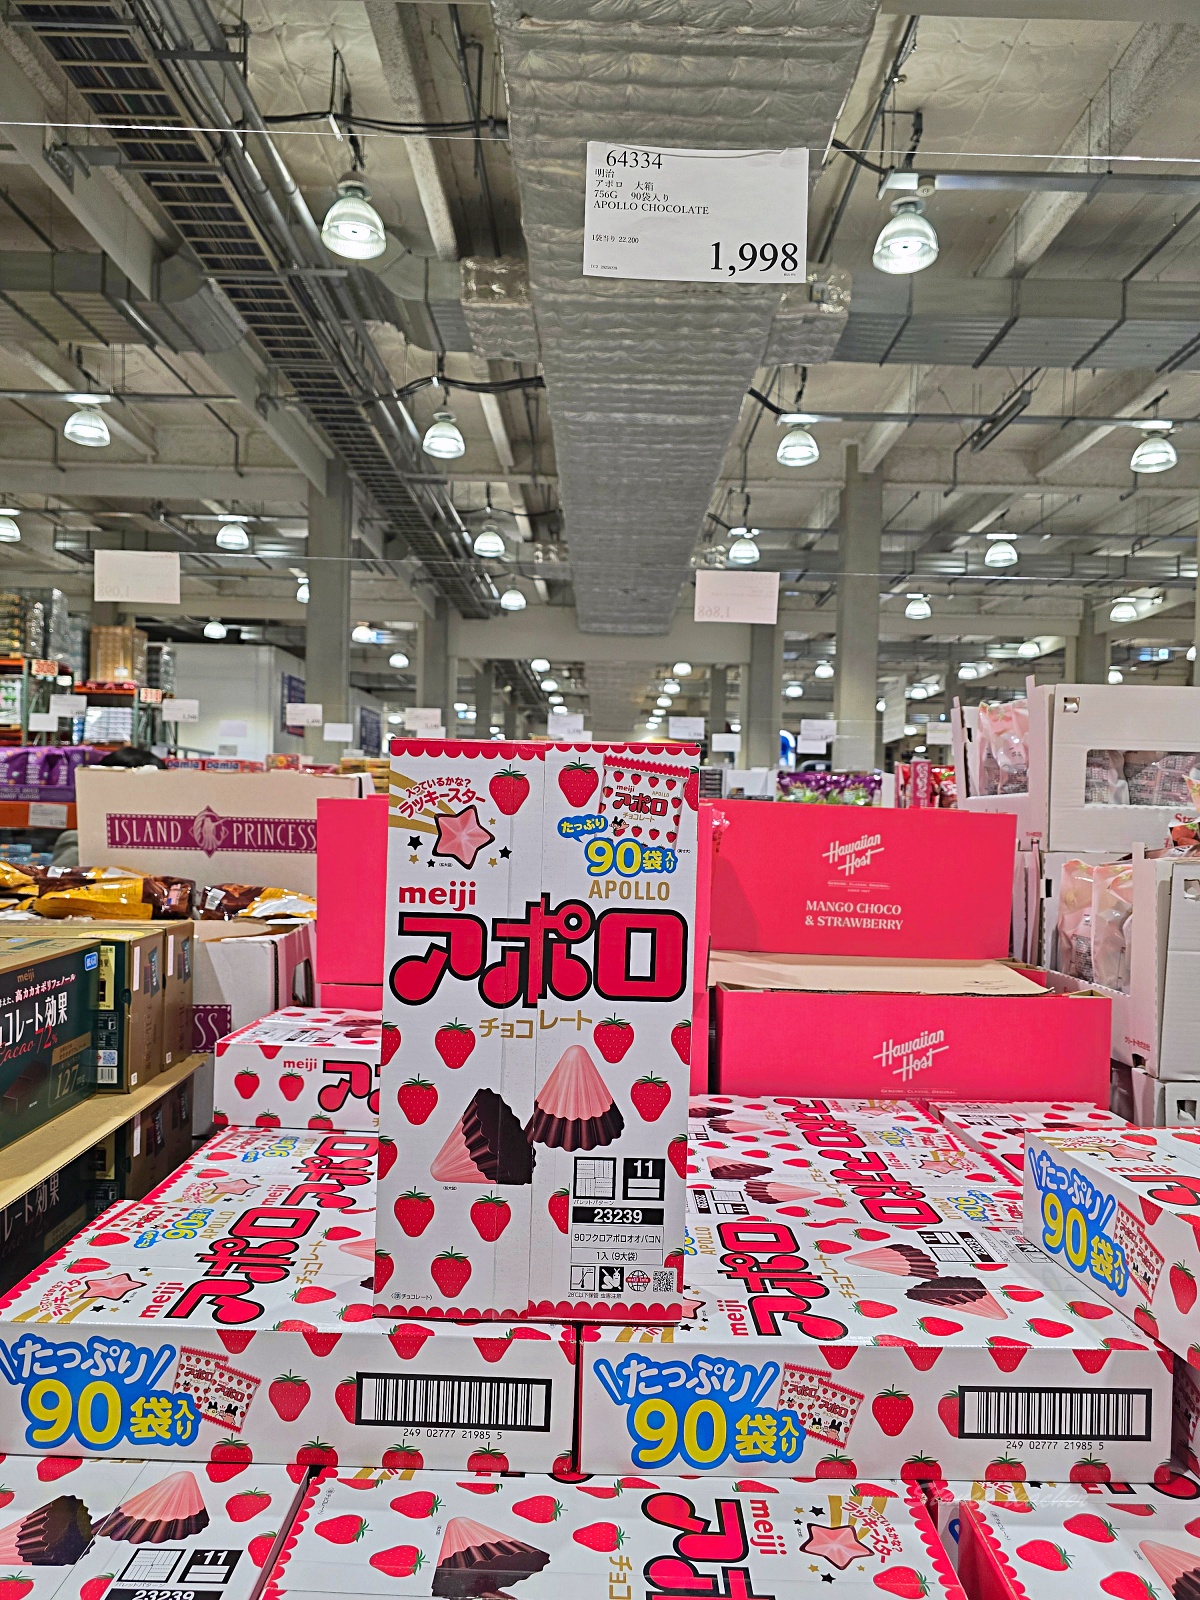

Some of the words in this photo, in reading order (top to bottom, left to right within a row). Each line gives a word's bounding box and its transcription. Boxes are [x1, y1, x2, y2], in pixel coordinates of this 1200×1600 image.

[594, 168, 615, 178] 明治
[606, 150, 663, 170] 64334
[594, 190, 618, 199] 756G
[630, 192, 670, 202] 90袋入り
[595, 179, 623, 188] アポロ
[634, 181, 654, 192] 大箱
[594, 200, 638, 210] APOLLO
[641, 203, 709, 214] CHOCOLATE
[710, 242, 798, 276] 1,998
[398, 788, 486, 819] ラッキースター
[612, 792, 668, 816] アポロ
[616, 785, 636, 794] meiji
[560, 818, 606, 834] たっぷり
[623, 812, 655, 822] チョコレート
[114, 820, 182, 846] ISLAND
[232, 823, 317, 851] PRINCESS
[822, 834, 881, 864] Hawaiian
[838, 848, 884, 876] Host
[399, 880, 476, 911] meiji
[588, 880, 670, 901] APOLLO
[806, 900, 854, 913] MANGO
[856, 902, 902, 916] CHOCO
[804, 916, 814, 926] &
[817, 916, 904, 930] STRAWBERRY
[389, 892, 688, 1009] アポロ
[16, 968, 35, 983] meiji
[478, 1009, 592, 1039] チョコレート
[873, 1030, 944, 1067] Hawaiian
[283, 1058, 318, 1072] meiji
[892, 1046, 950, 1082] Host
[634, 1160, 654, 1178] 11
[882, 1151, 911, 1170] meiji
[1106, 1165, 1178, 1174] meiji
[261, 1184, 291, 1206] meiji
[817, 1150, 944, 1224] アポロ
[1039, 1158, 1101, 1221] たっぷり
[199, 1211, 236, 1240] APOLLO
[594, 1208, 643, 1224] 23239
[695, 1226, 716, 1256] APOLLO
[1043, 1192, 1127, 1290] 90袋入り
[164, 1207, 320, 1324] アポロ
[296, 1240, 327, 1285] チョコレート
[596, 1252, 609, 1261] 1入
[717, 1222, 848, 1341] アポロ
[814, 1254, 861, 1300] チョコレート
[138, 1281, 184, 1319] meiji
[717, 1299, 749, 1337] meiji
[18, 1340, 148, 1384] たっぷり
[622, 1360, 752, 1402] たっぷり
[28, 1378, 195, 1444] 90袋入り
[404, 1428, 420, 1438] 249
[426, 1428, 456, 1438] 02777
[462, 1430, 491, 1440] 21985
[496, 1431, 502, 1440] 5
[633, 1398, 800, 1464] 90袋入り
[1006, 1440, 1024, 1450] 249
[1028, 1440, 1058, 1450] 02777
[1064, 1441, 1092, 1450] 21985
[1098, 1441, 1104, 1450] 5
[750, 1499, 787, 1556] meiji
[842, 1501, 892, 1564] ラッキースター
[204, 1550, 230, 1565] 11
